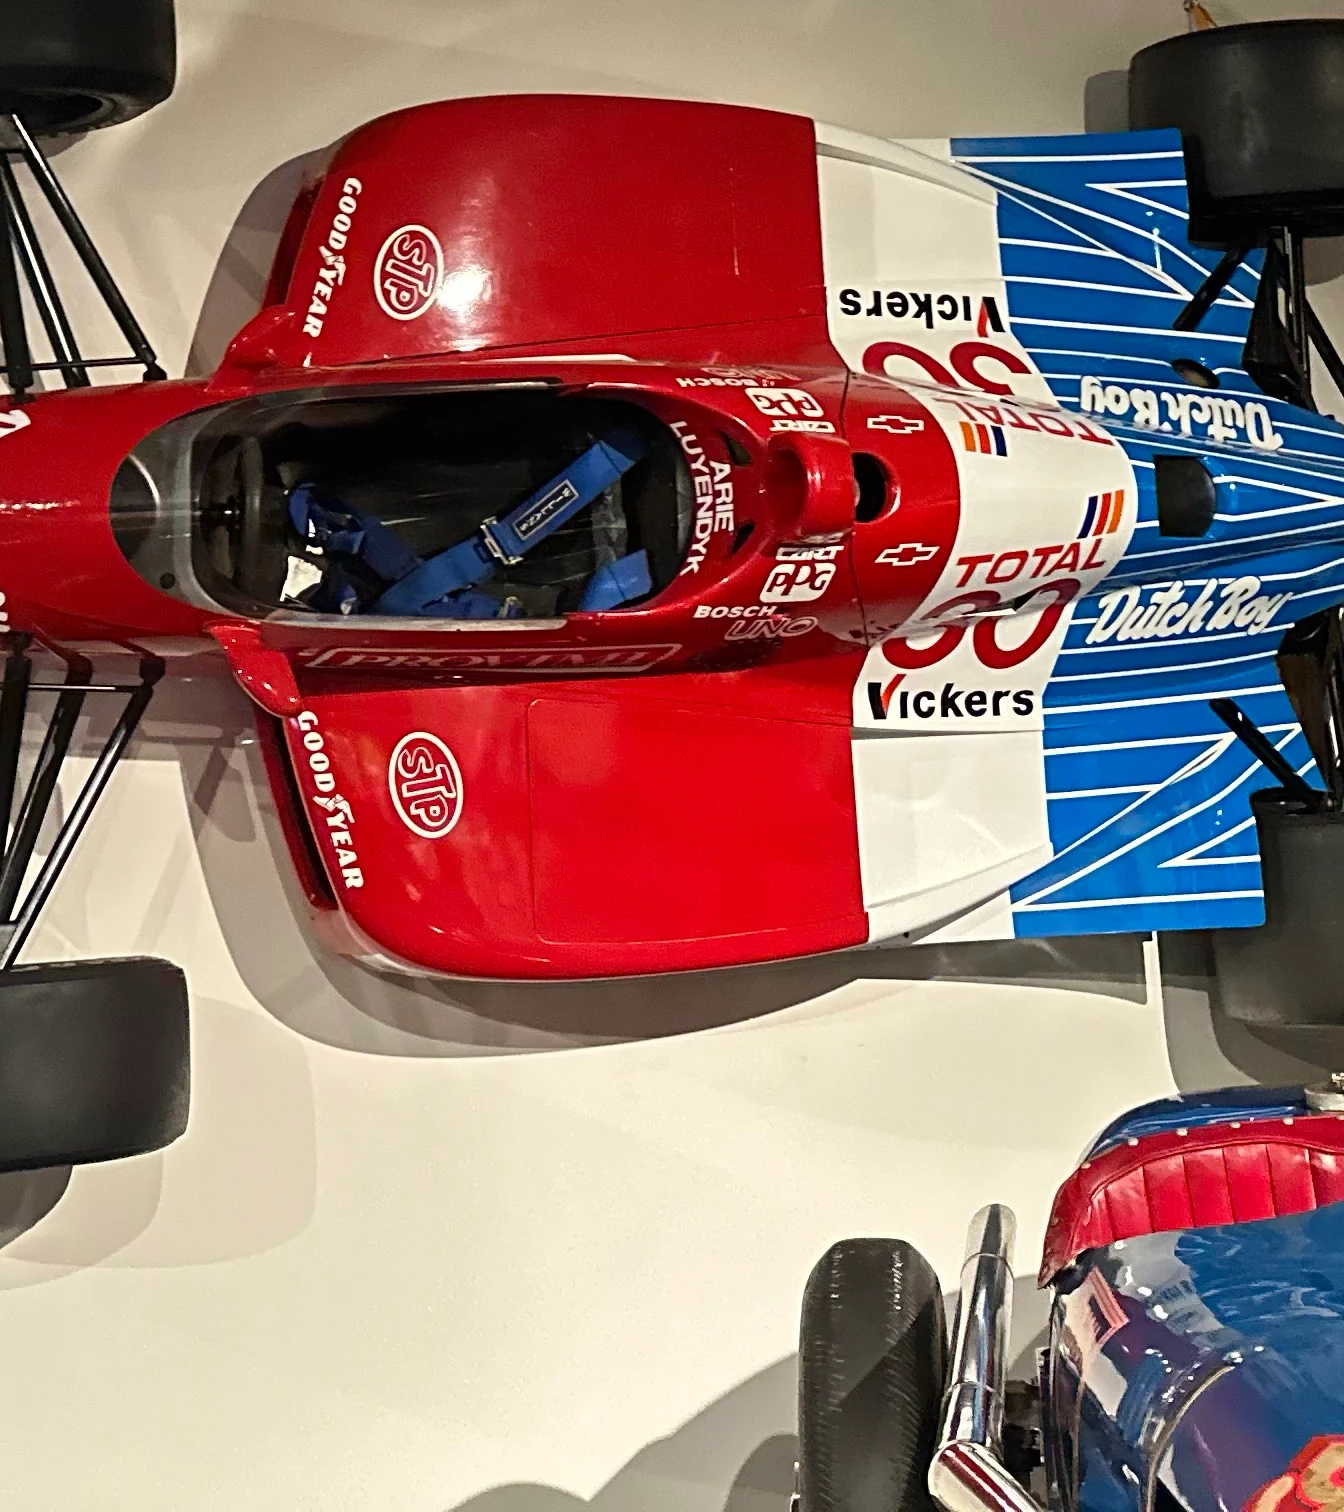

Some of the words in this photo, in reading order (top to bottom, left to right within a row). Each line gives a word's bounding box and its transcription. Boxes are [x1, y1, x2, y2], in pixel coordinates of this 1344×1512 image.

[383, 233, 435, 311] STP
[839, 288, 1007, 338] Vickers
[676, 377, 760, 388] BOSCH
[751, 391, 820, 417] PPG
[1079, 375, 1172, 431] Boy
[1161, 391, 1284, 451] Dutch
[669, 420, 714, 577] LUYENDYK
[709, 460, 735, 533] ARIE
[764, 564, 833, 598] PPG
[956, 537, 1106, 587] TOTAL
[693, 605, 778, 620] BOSCH
[724, 615, 820, 641] UNO
[1085, 578, 1219, 645] Dutch
[1205, 575, 1295, 636] Boy
[867, 673, 1036, 721] Vickers
[397, 746, 457, 827] STP
